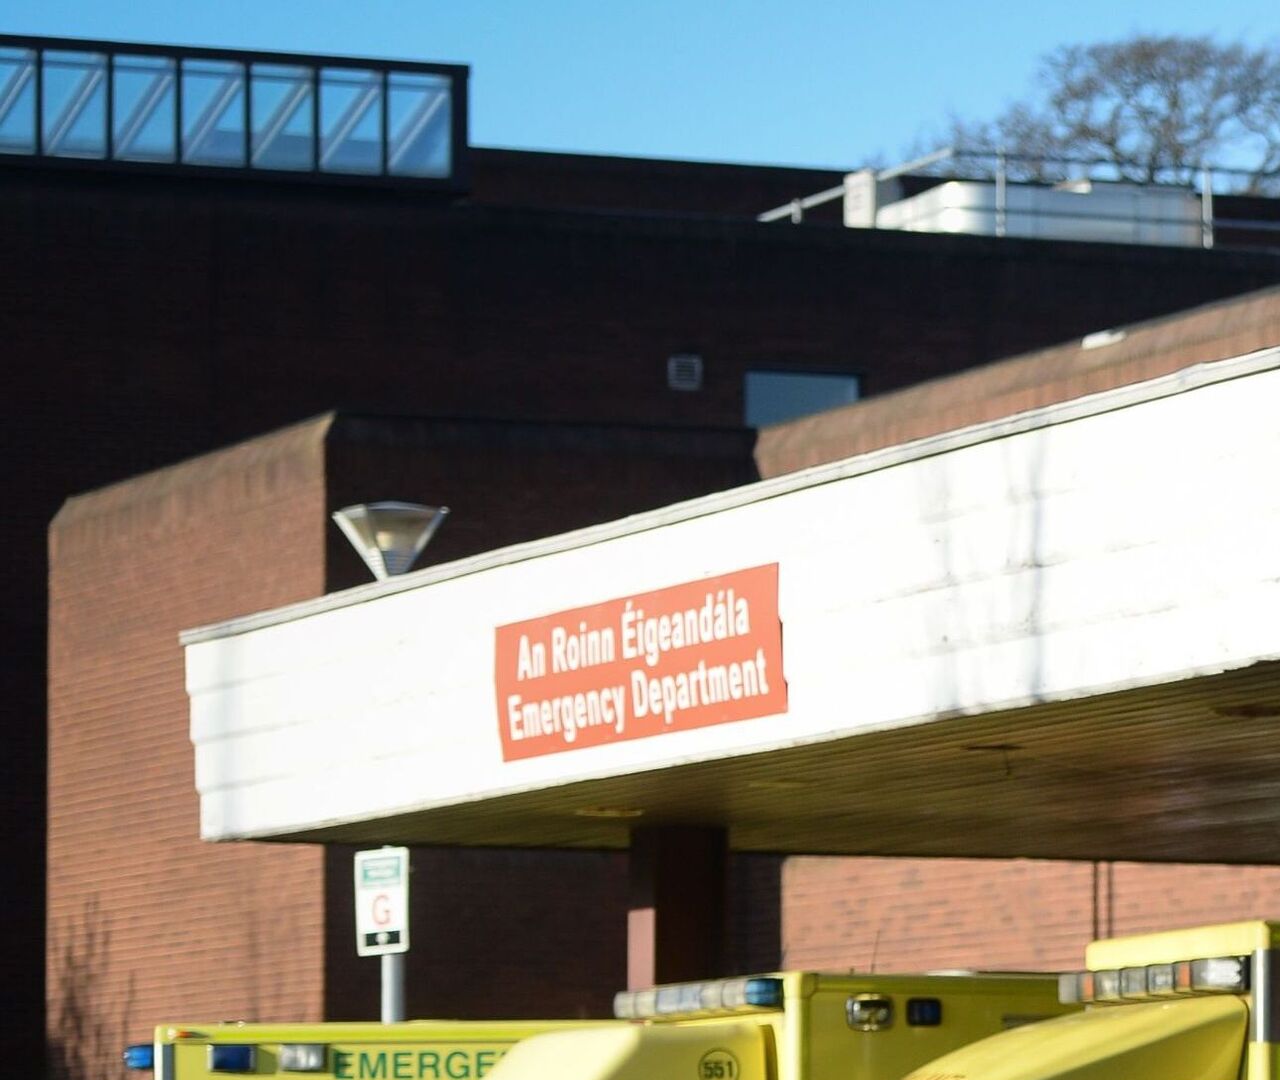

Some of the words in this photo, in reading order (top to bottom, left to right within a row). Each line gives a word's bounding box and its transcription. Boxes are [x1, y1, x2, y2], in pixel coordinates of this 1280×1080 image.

[517, 634, 546, 681] An
[552, 621, 615, 674] Roinn
[621, 588, 751, 667] Éigeandála
[507, 684, 626, 743] Emergency
[631, 647, 770, 725] Department
[334, 1051, 507, 1080] EMERGE
[703, 1060, 733, 1080] 551
